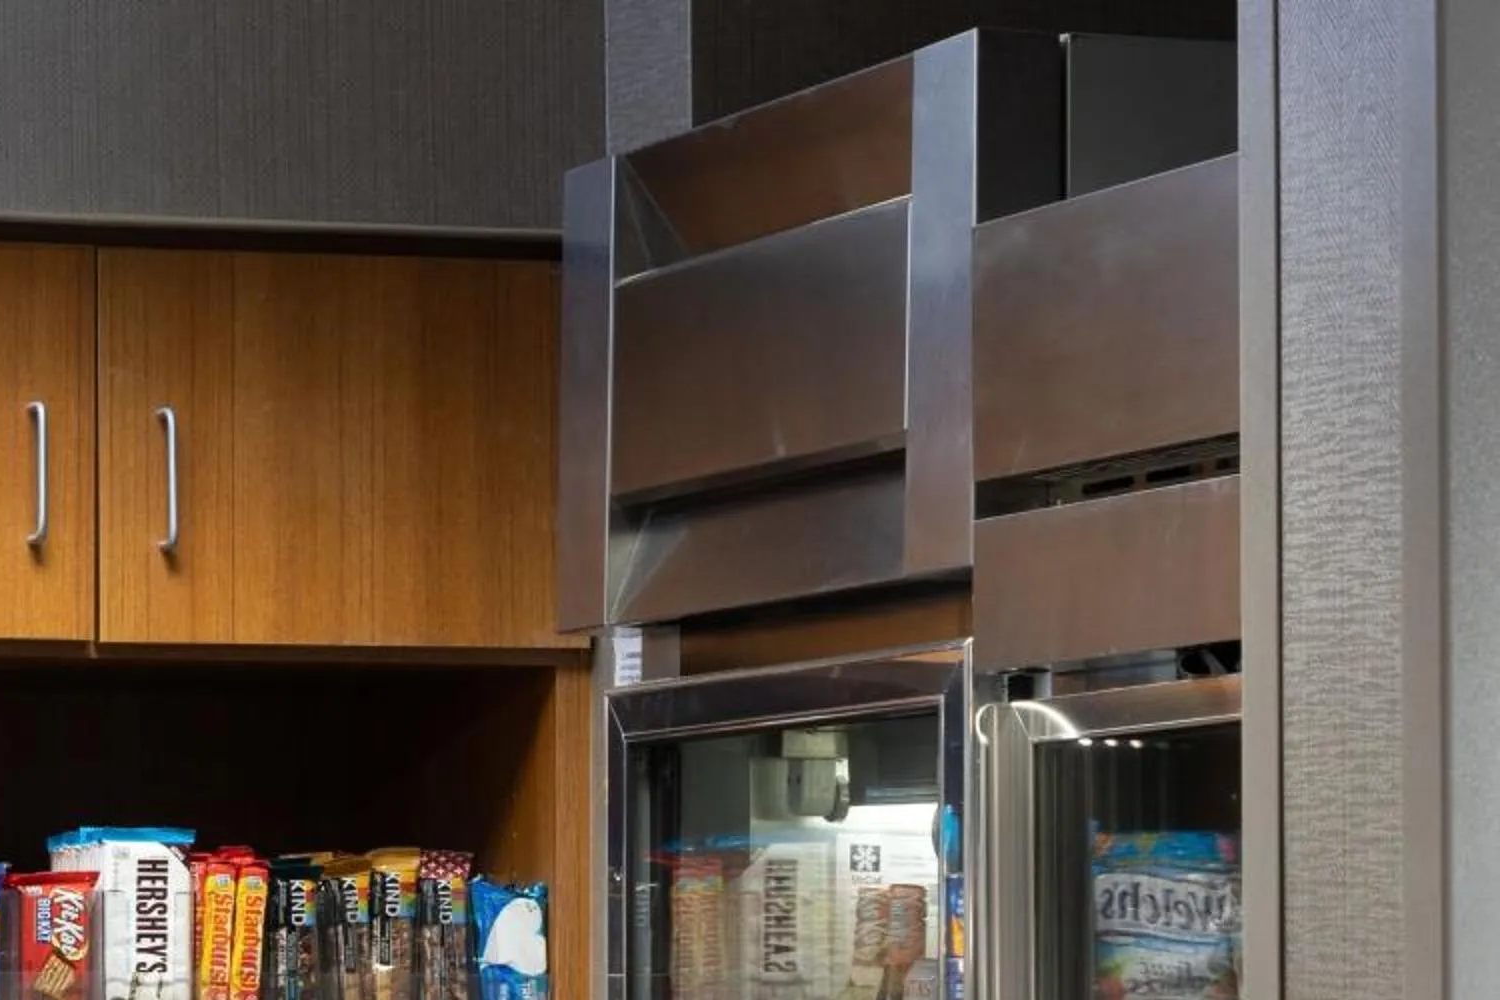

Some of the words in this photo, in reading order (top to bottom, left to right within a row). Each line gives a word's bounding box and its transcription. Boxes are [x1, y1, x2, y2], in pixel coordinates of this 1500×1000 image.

[135, 859, 169, 974] HERSHEY'S
[289, 879, 308, 927] KIND
[341, 877, 360, 923] KIND
[385, 871, 400, 917] KIND
[437, 879, 453, 924] KIND
